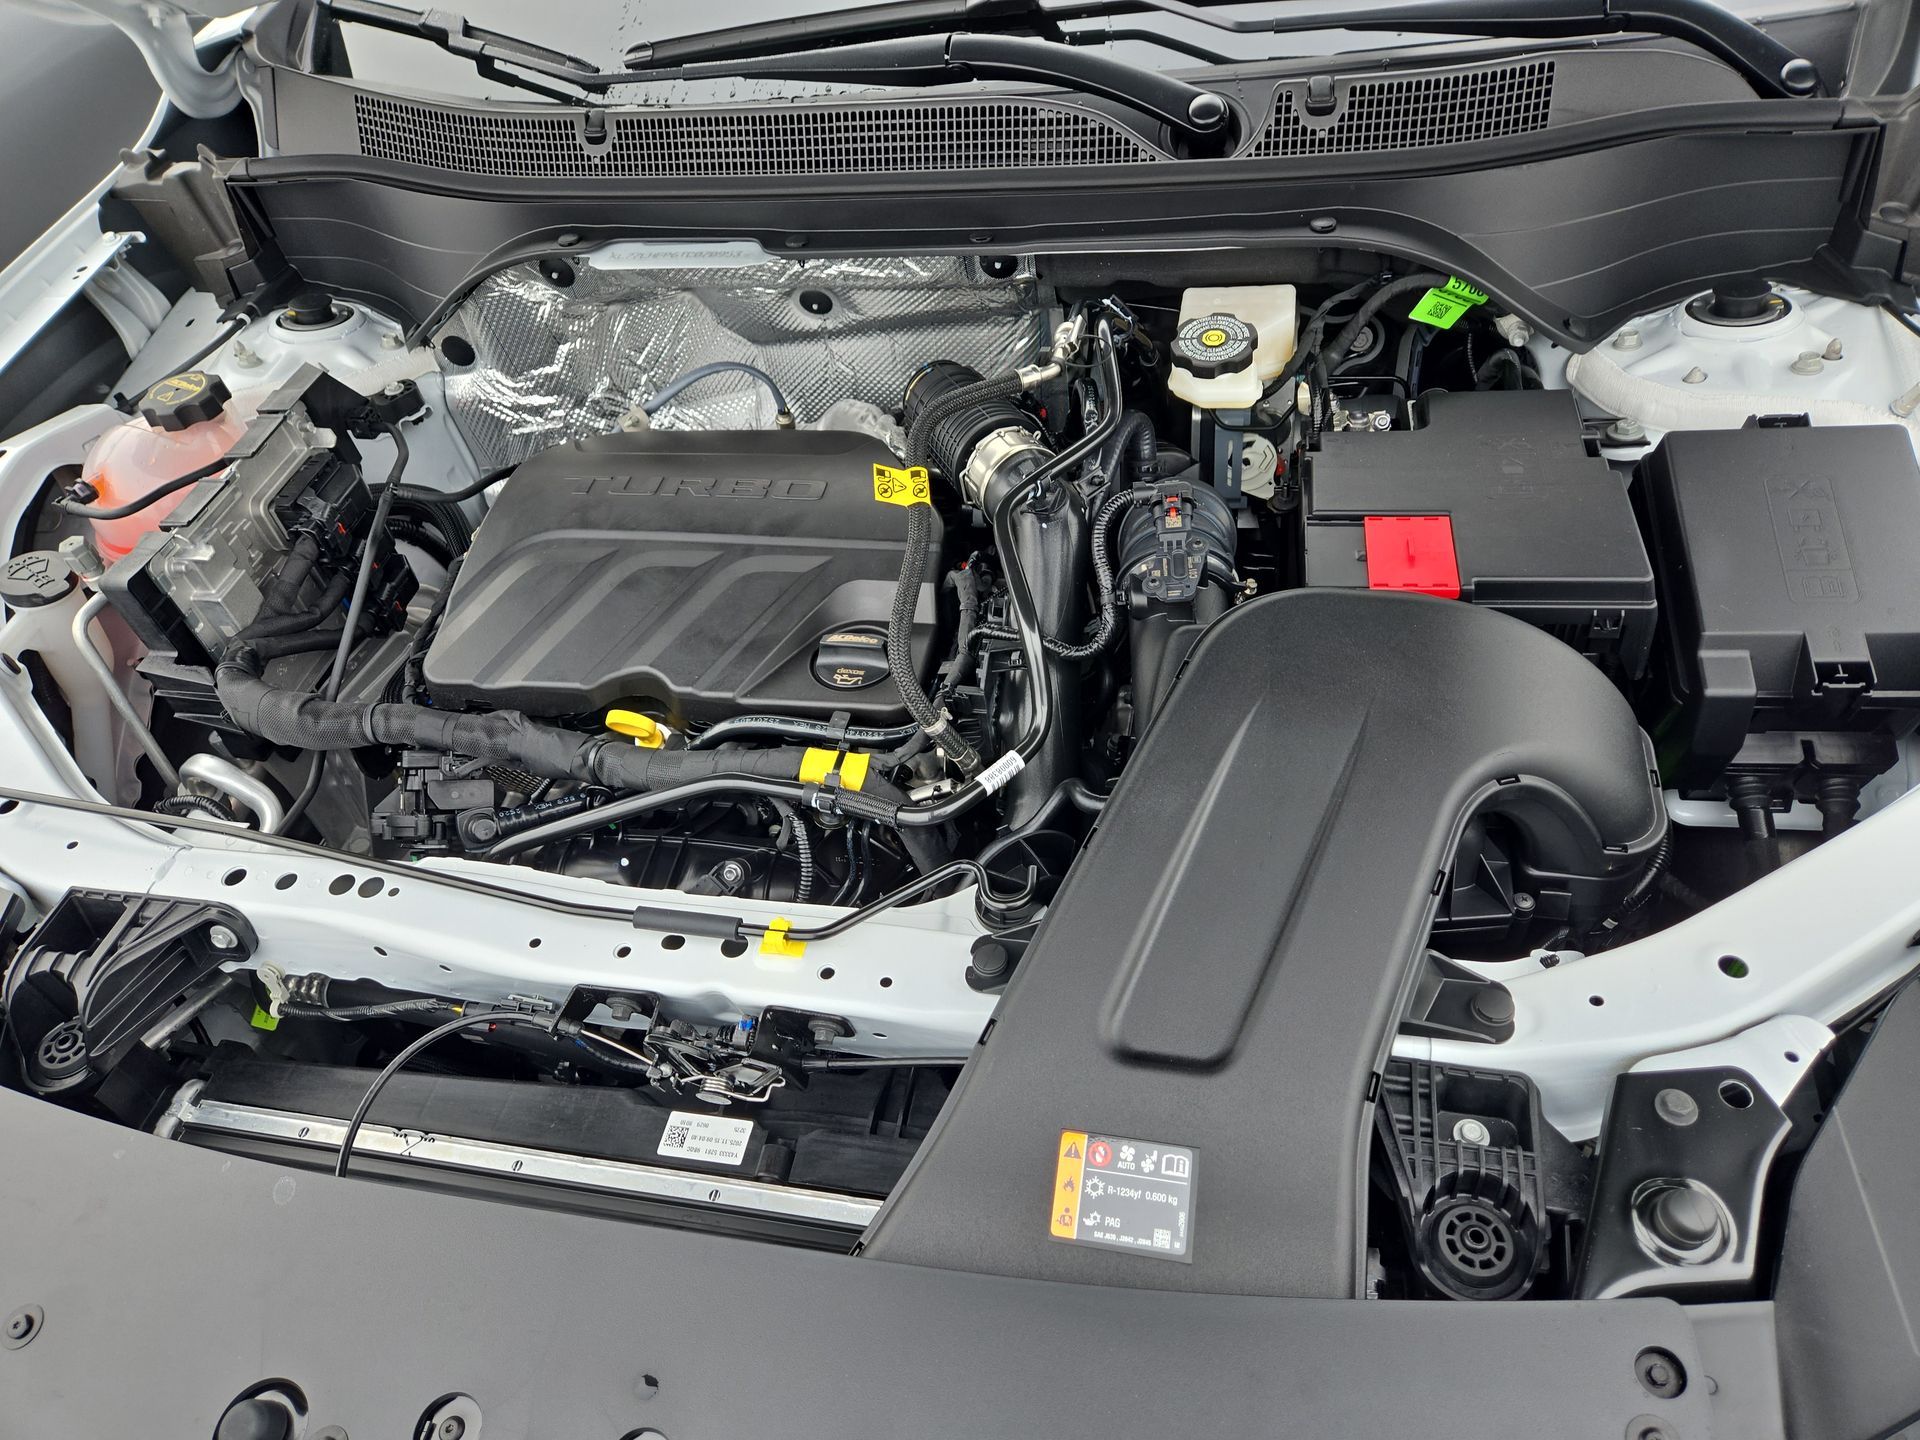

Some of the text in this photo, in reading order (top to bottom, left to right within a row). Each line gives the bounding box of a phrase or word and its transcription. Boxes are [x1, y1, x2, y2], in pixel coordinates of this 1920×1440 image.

[563, 475, 829, 501] TURBO
[826, 634, 879, 645] ACDelco
[836, 667, 866, 676] dexos
[1117, 1160, 1136, 1171] AUTO
[1107, 1185, 1178, 1206] R-1234yf 0.600 kg
[1104, 1216, 1121, 1228] PAG
